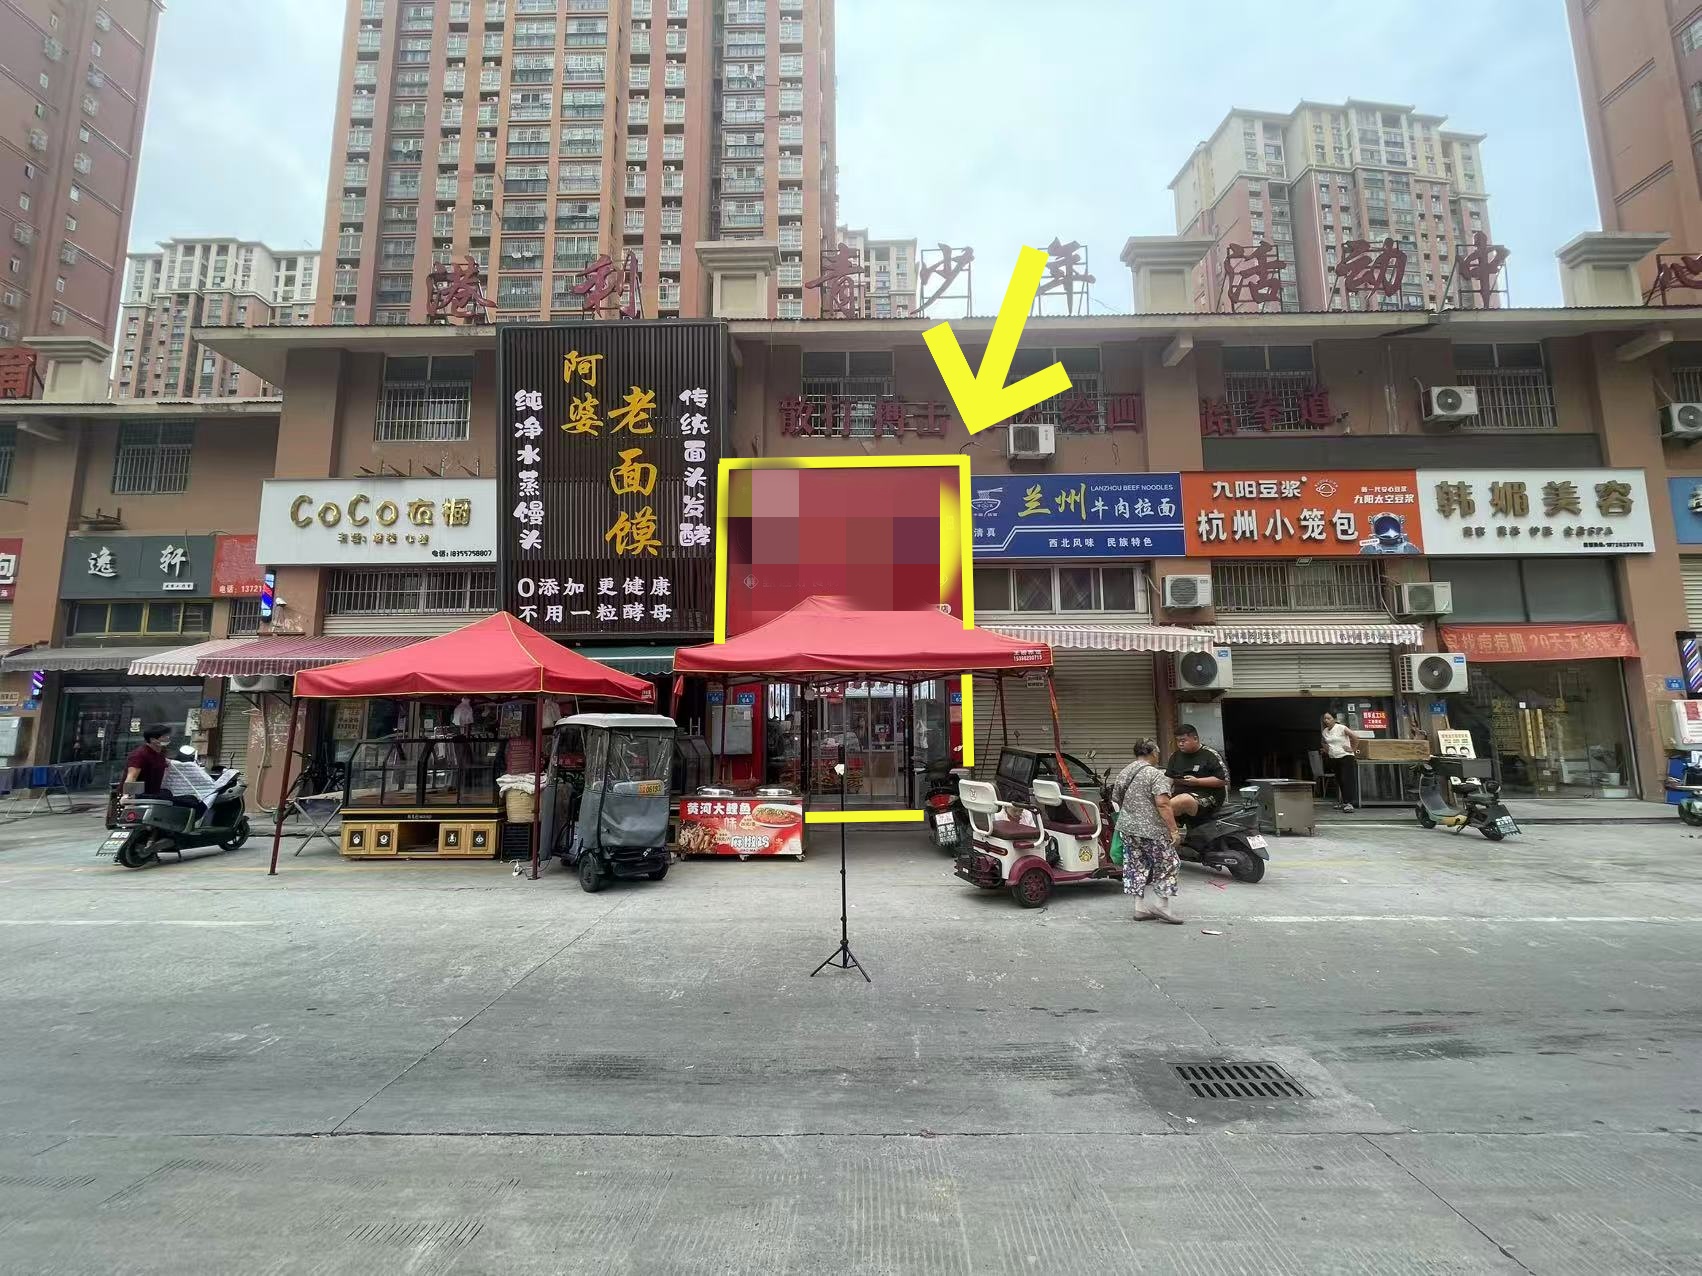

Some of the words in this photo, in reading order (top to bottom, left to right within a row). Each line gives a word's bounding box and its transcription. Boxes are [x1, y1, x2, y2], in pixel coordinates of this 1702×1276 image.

[560, 350, 605, 436] 阿婆
[513, 388, 545, 550] 纯净水蒸馒头
[604, 385, 663, 556] 老面馍
[678, 387, 712, 547] 传统面头发酵
[1017, 482, 1087, 521] 兰州
[1090, 496, 1176, 520] 牛肉拉面
[1212, 479, 1301, 498] 九阳豆浆
[1353, 494, 1414, 504] 九阳太空豆浆
[1197, 508, 1358, 541] 杭州小笼包
[1049, 537, 1095, 548] 西北风味
[1107, 536, 1153, 547] 民族特色
[597, 576, 672, 597] 更健康
[518, 604, 673, 623] 不用一粒酵母
